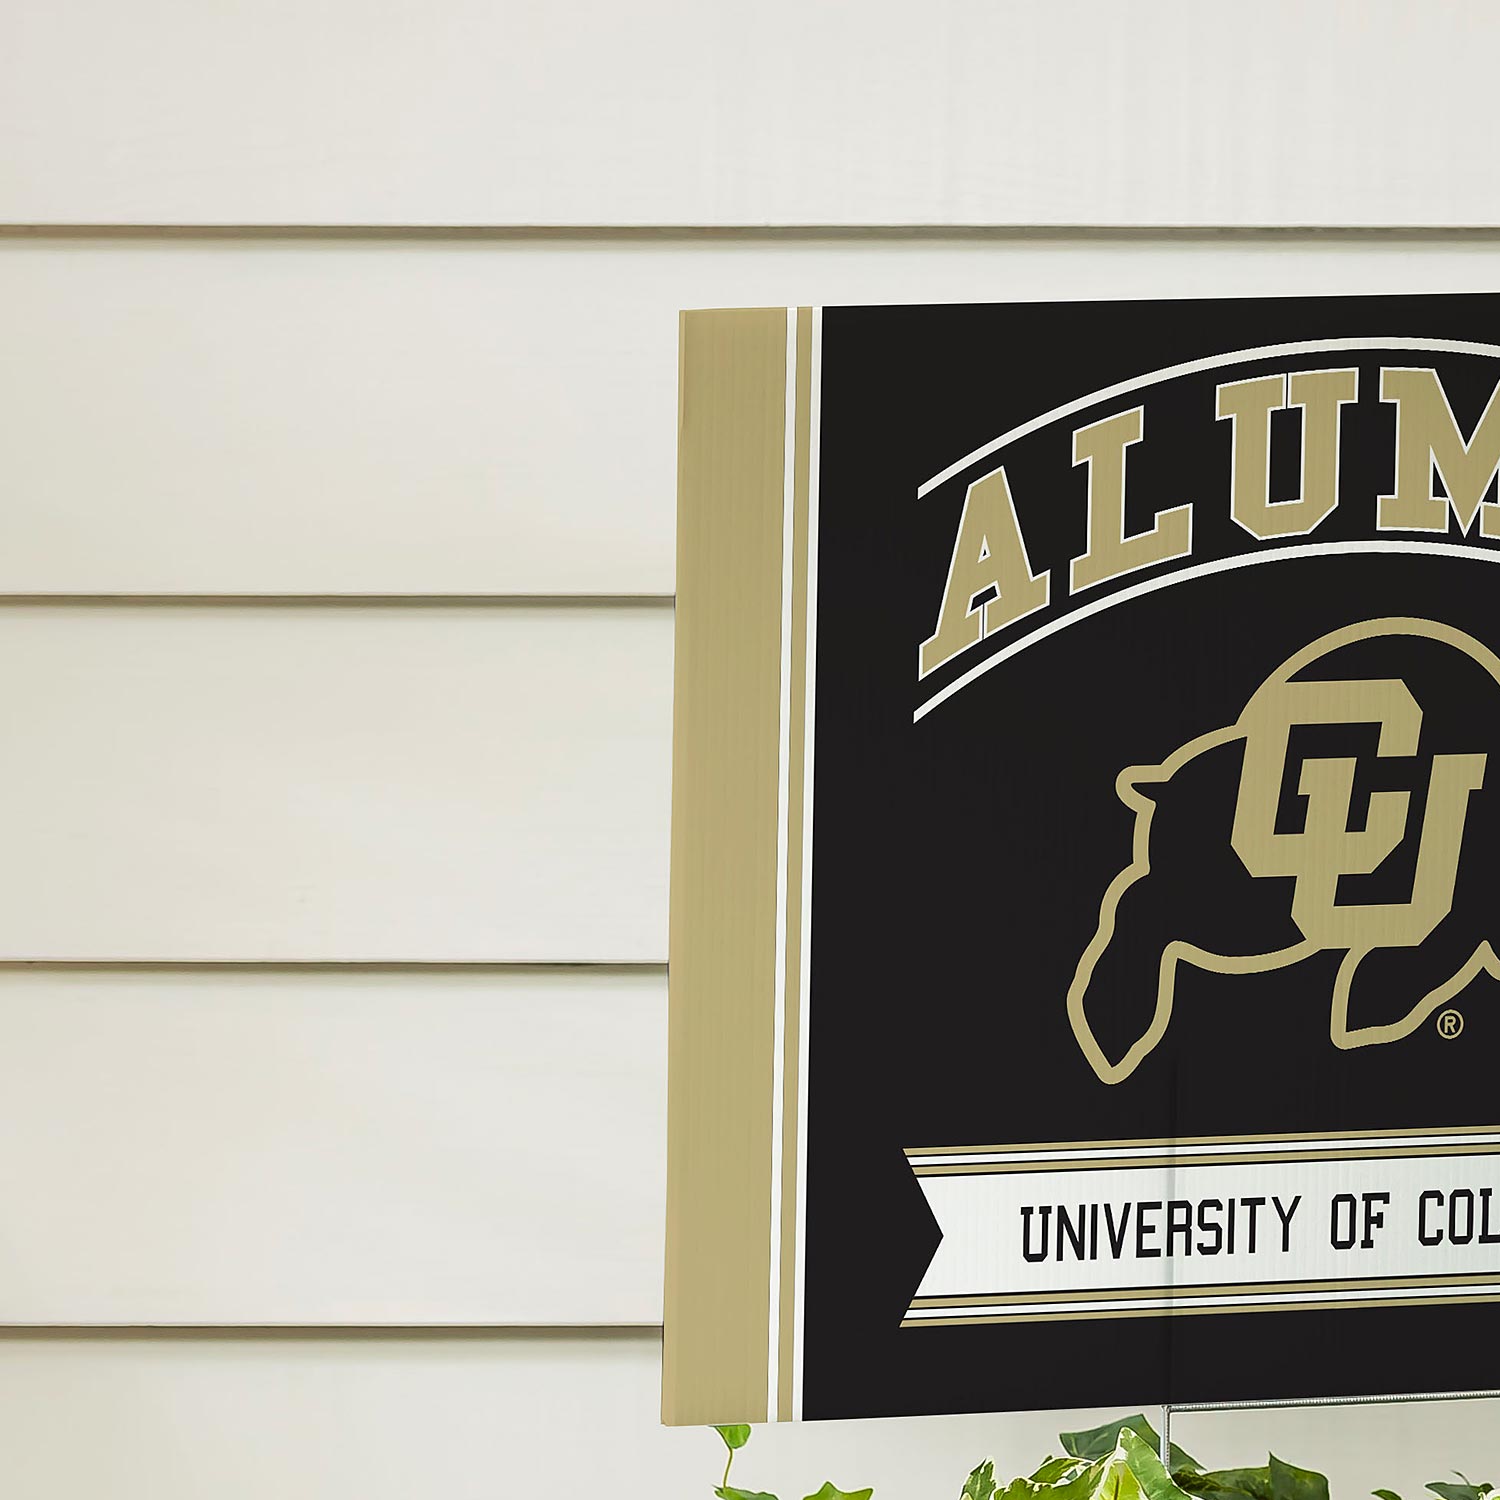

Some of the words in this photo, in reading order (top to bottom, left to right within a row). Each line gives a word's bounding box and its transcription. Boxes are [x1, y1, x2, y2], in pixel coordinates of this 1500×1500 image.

[1231, 678, 1488, 948] CU
[1020, 1195, 1303, 1262] UNIVERSITY
[1330, 1192, 1390, 1251] OF
